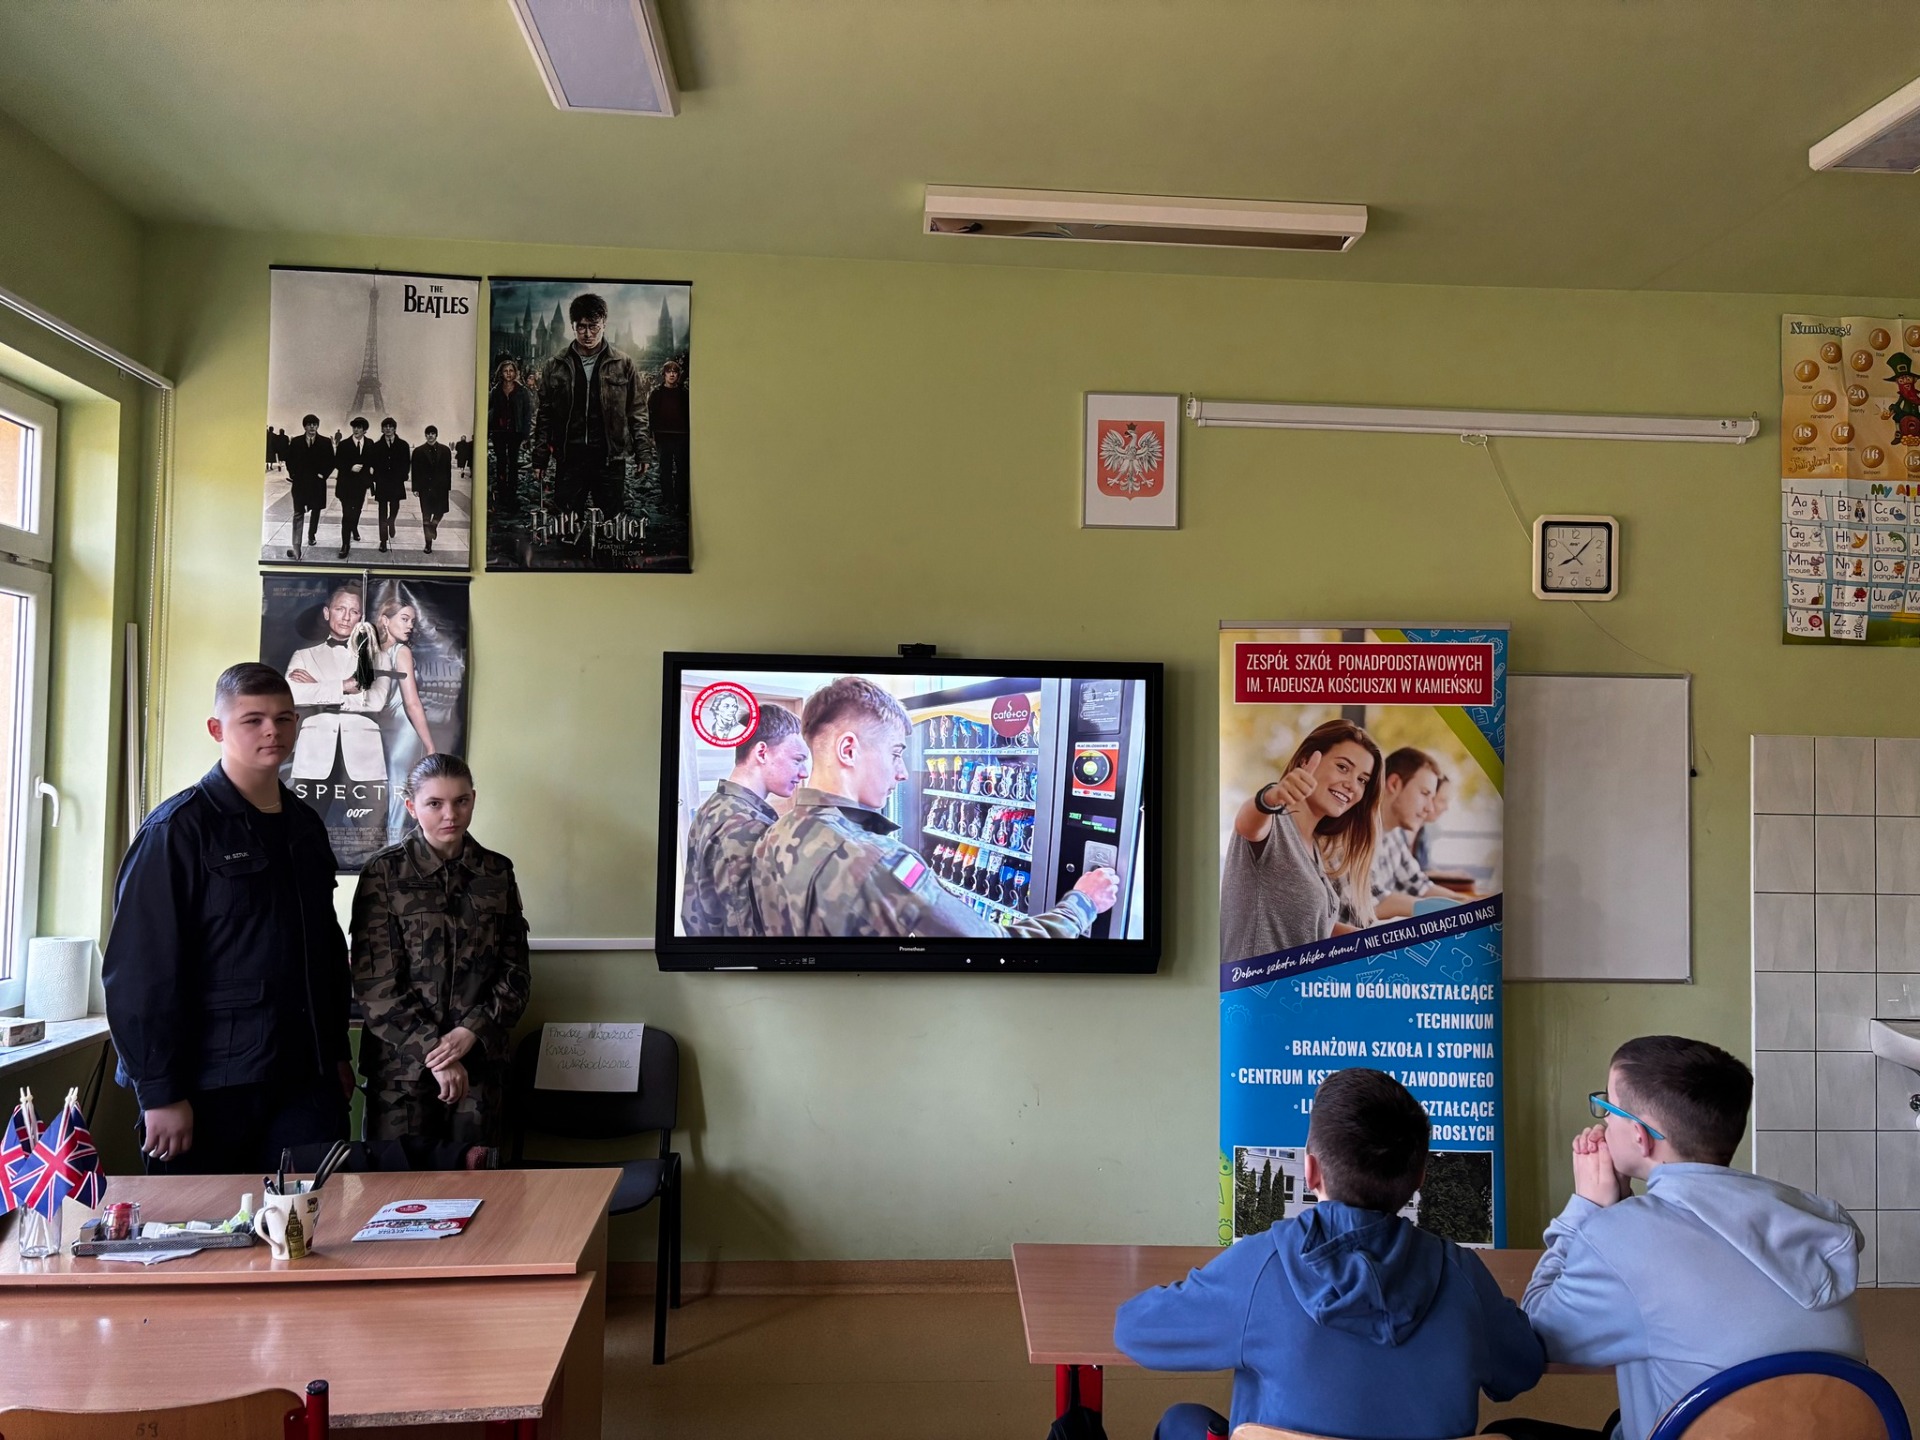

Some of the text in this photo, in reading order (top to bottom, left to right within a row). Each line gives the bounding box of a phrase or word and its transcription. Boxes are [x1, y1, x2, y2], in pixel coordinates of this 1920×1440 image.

[430, 285, 444, 293] THE
[404, 284, 469, 318] BEATLES
[1790, 321, 1852, 337] Numbers!
[1826, 346, 1835, 356] 2
[1858, 354, 1866, 365] 3
[1804, 364, 1809, 374] 1
[1817, 394, 1831, 405] 19
[1850, 389, 1864, 400] 20
[1797, 428, 1812, 438] 18
[1836, 426, 1849, 437] 17
[1866, 449, 1878, 459] 16
[1788, 454, 1831, 473] Fairyland
[1908, 456, 1920, 466] 15
[1871, 484, 1892, 498] My
[1791, 496, 1808, 508] Aa
[1838, 500, 1852, 512] Bb
[1874, 503, 1888, 514] Cc
[530, 508, 649, 558] Harry Potter
[1558, 528, 1564, 538] 11
[1572, 528, 1580, 539] 12
[1790, 528, 1805, 541] Gg
[1836, 531, 1850, 543] Hh
[1876, 533, 1884, 545] Ii
[1548, 539, 1558, 548] 10
[1596, 540, 1602, 549] 2
[1548, 552, 1554, 561] 9
[1596, 554, 1602, 563] 3
[1788, 554, 1809, 566] Mm
[1836, 557, 1850, 569] Nn
[1874, 560, 1888, 572] Oo
[1547, 568, 1553, 577] 8
[1595, 569, 1601, 577] 4
[1558, 576, 1564, 586] 7
[1570, 576, 1577, 586] 6
[1585, 576, 1592, 586] 5
[1792, 584, 1804, 595] Ss
[1834, 587, 1845, 599] Tt
[1873, 590, 1886, 602] Uu
[1790, 611, 1802, 625] Yy
[1834, 615, 1846, 626] Zz
[1246, 651, 1483, 672] ZESPÓŁ SZKÓŁ PONADPODSTAWOWYCH
[1246, 674, 1483, 694] IM. TADEUSZA KOŚCIUSZKI W KAMIEŃSKU
[295, 784, 406, 800] SPECTR
[346, 809, 371, 818] 007
[1231, 905, 1496, 983] Dobra szkoła blisko domu! NIE CZEKAJ, DOŁĄCZ DO NAS!
[1301, 978, 1494, 1005] LICEUM OGÓLNOKSZTAŁCĄCE
[1416, 1013, 1494, 1030] TECHNIKUM
[1292, 1036, 1494, 1059] BRANŻOWA SZKOŁA I STOPNIA
[1239, 1068, 1303, 1084] CENTRUM
[1401, 1071, 1494, 1088] ZAWODOWEGO
[1420, 1101, 1495, 1121] SZTAŁCĄCE
[1432, 1124, 1495, 1142] ROSŁYCH
